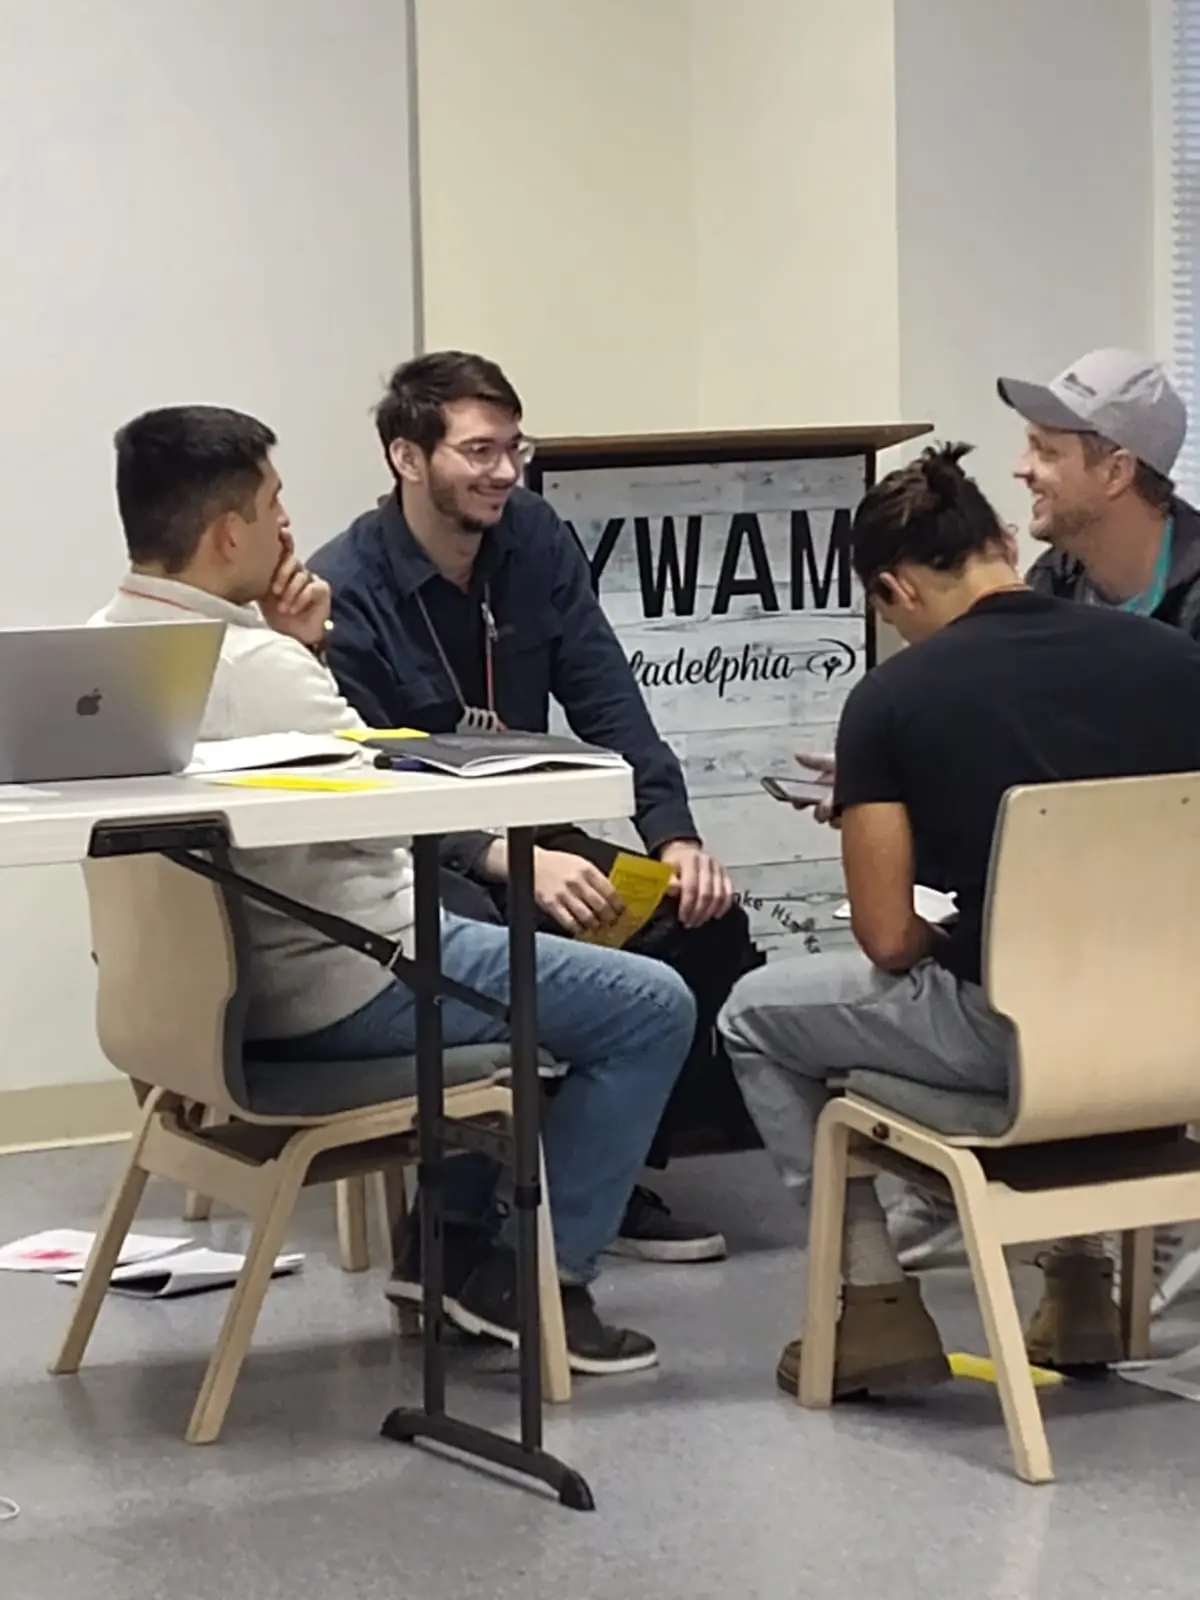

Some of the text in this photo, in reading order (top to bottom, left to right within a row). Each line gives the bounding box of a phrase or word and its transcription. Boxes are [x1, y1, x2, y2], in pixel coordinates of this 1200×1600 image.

[563, 508, 851, 618] YWAM
[629, 643, 794, 698] ladelphia
[732, 890, 763, 911] ake
